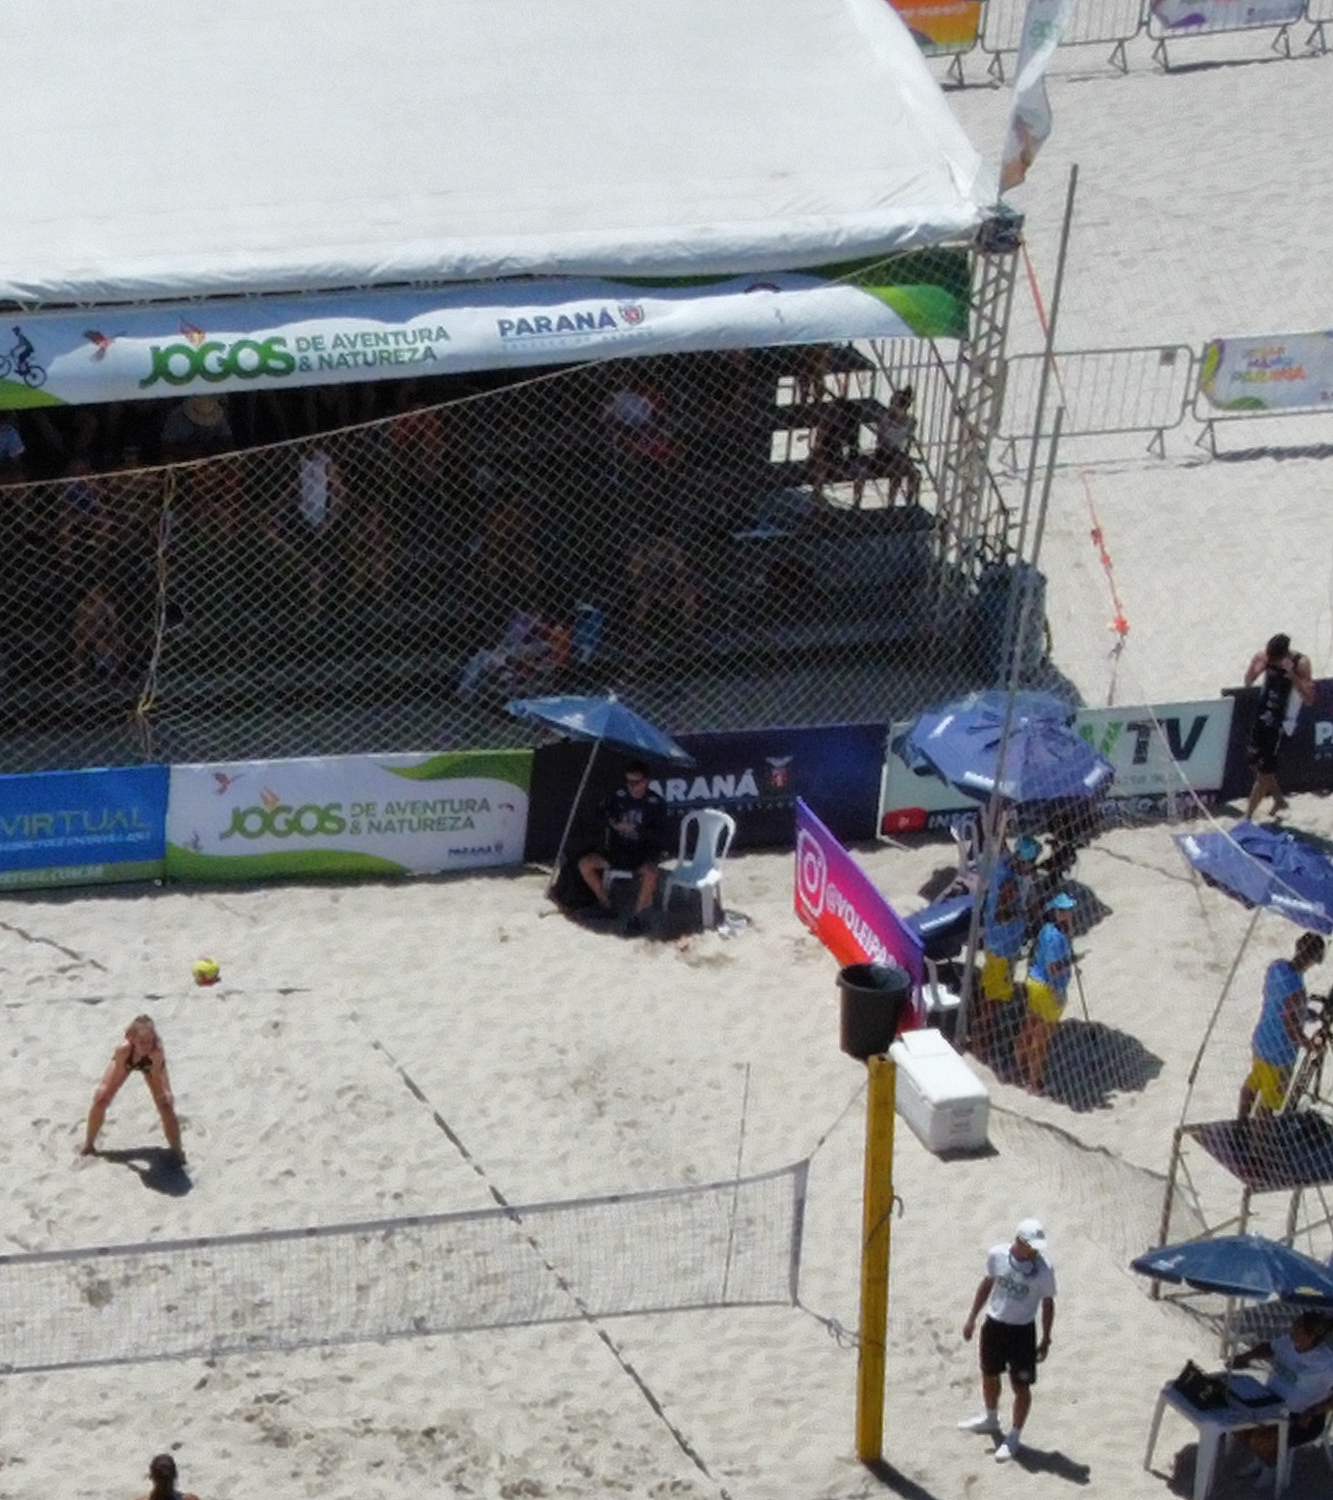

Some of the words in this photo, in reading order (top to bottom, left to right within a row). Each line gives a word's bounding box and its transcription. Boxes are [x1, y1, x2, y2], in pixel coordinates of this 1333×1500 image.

[497, 307, 617, 337] PARANÁ
[295, 336, 325, 353] DE
[333, 326, 450, 350] AVENTURA
[138, 336, 295, 390] JOGOS
[298, 355, 314, 373] &
[318, 346, 438, 372] NATUREZA
[649, 767, 759, 802] ARANÁ
[349, 802, 376, 818] DE
[384, 797, 492, 816] AVENTURA
[219, 803, 347, 841] JOGOS
[349, 820, 364, 836] &
[367, 815, 476, 835] NATUREZA
